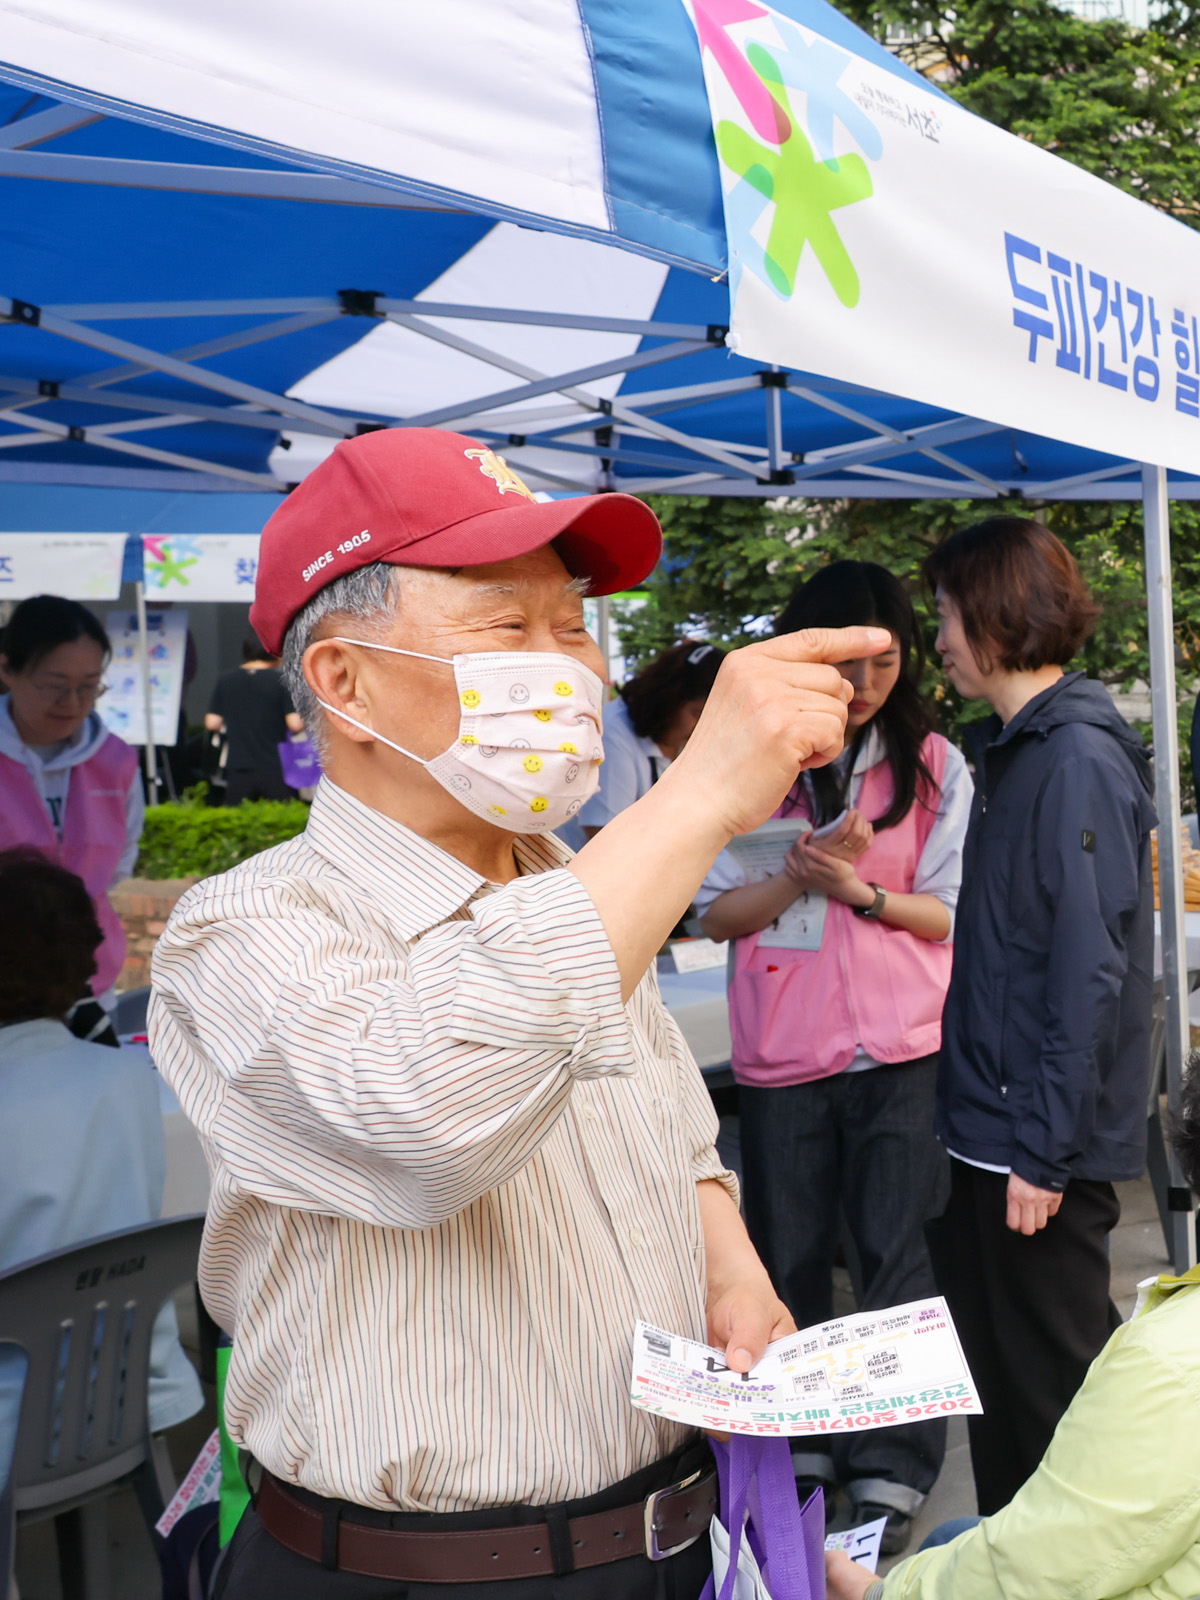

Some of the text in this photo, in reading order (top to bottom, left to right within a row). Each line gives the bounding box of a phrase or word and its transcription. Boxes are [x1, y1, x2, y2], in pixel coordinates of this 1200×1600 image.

[1004, 231, 1161, 403] 두피건강
[302, 530, 372, 582] SINCE 1905
[913, 1322, 946, 1335] 마지막!
[701, 1397, 973, 1433] 2026 찾아가는 보건소
[750, 1383, 970, 1422] 건강체험관 배치도
